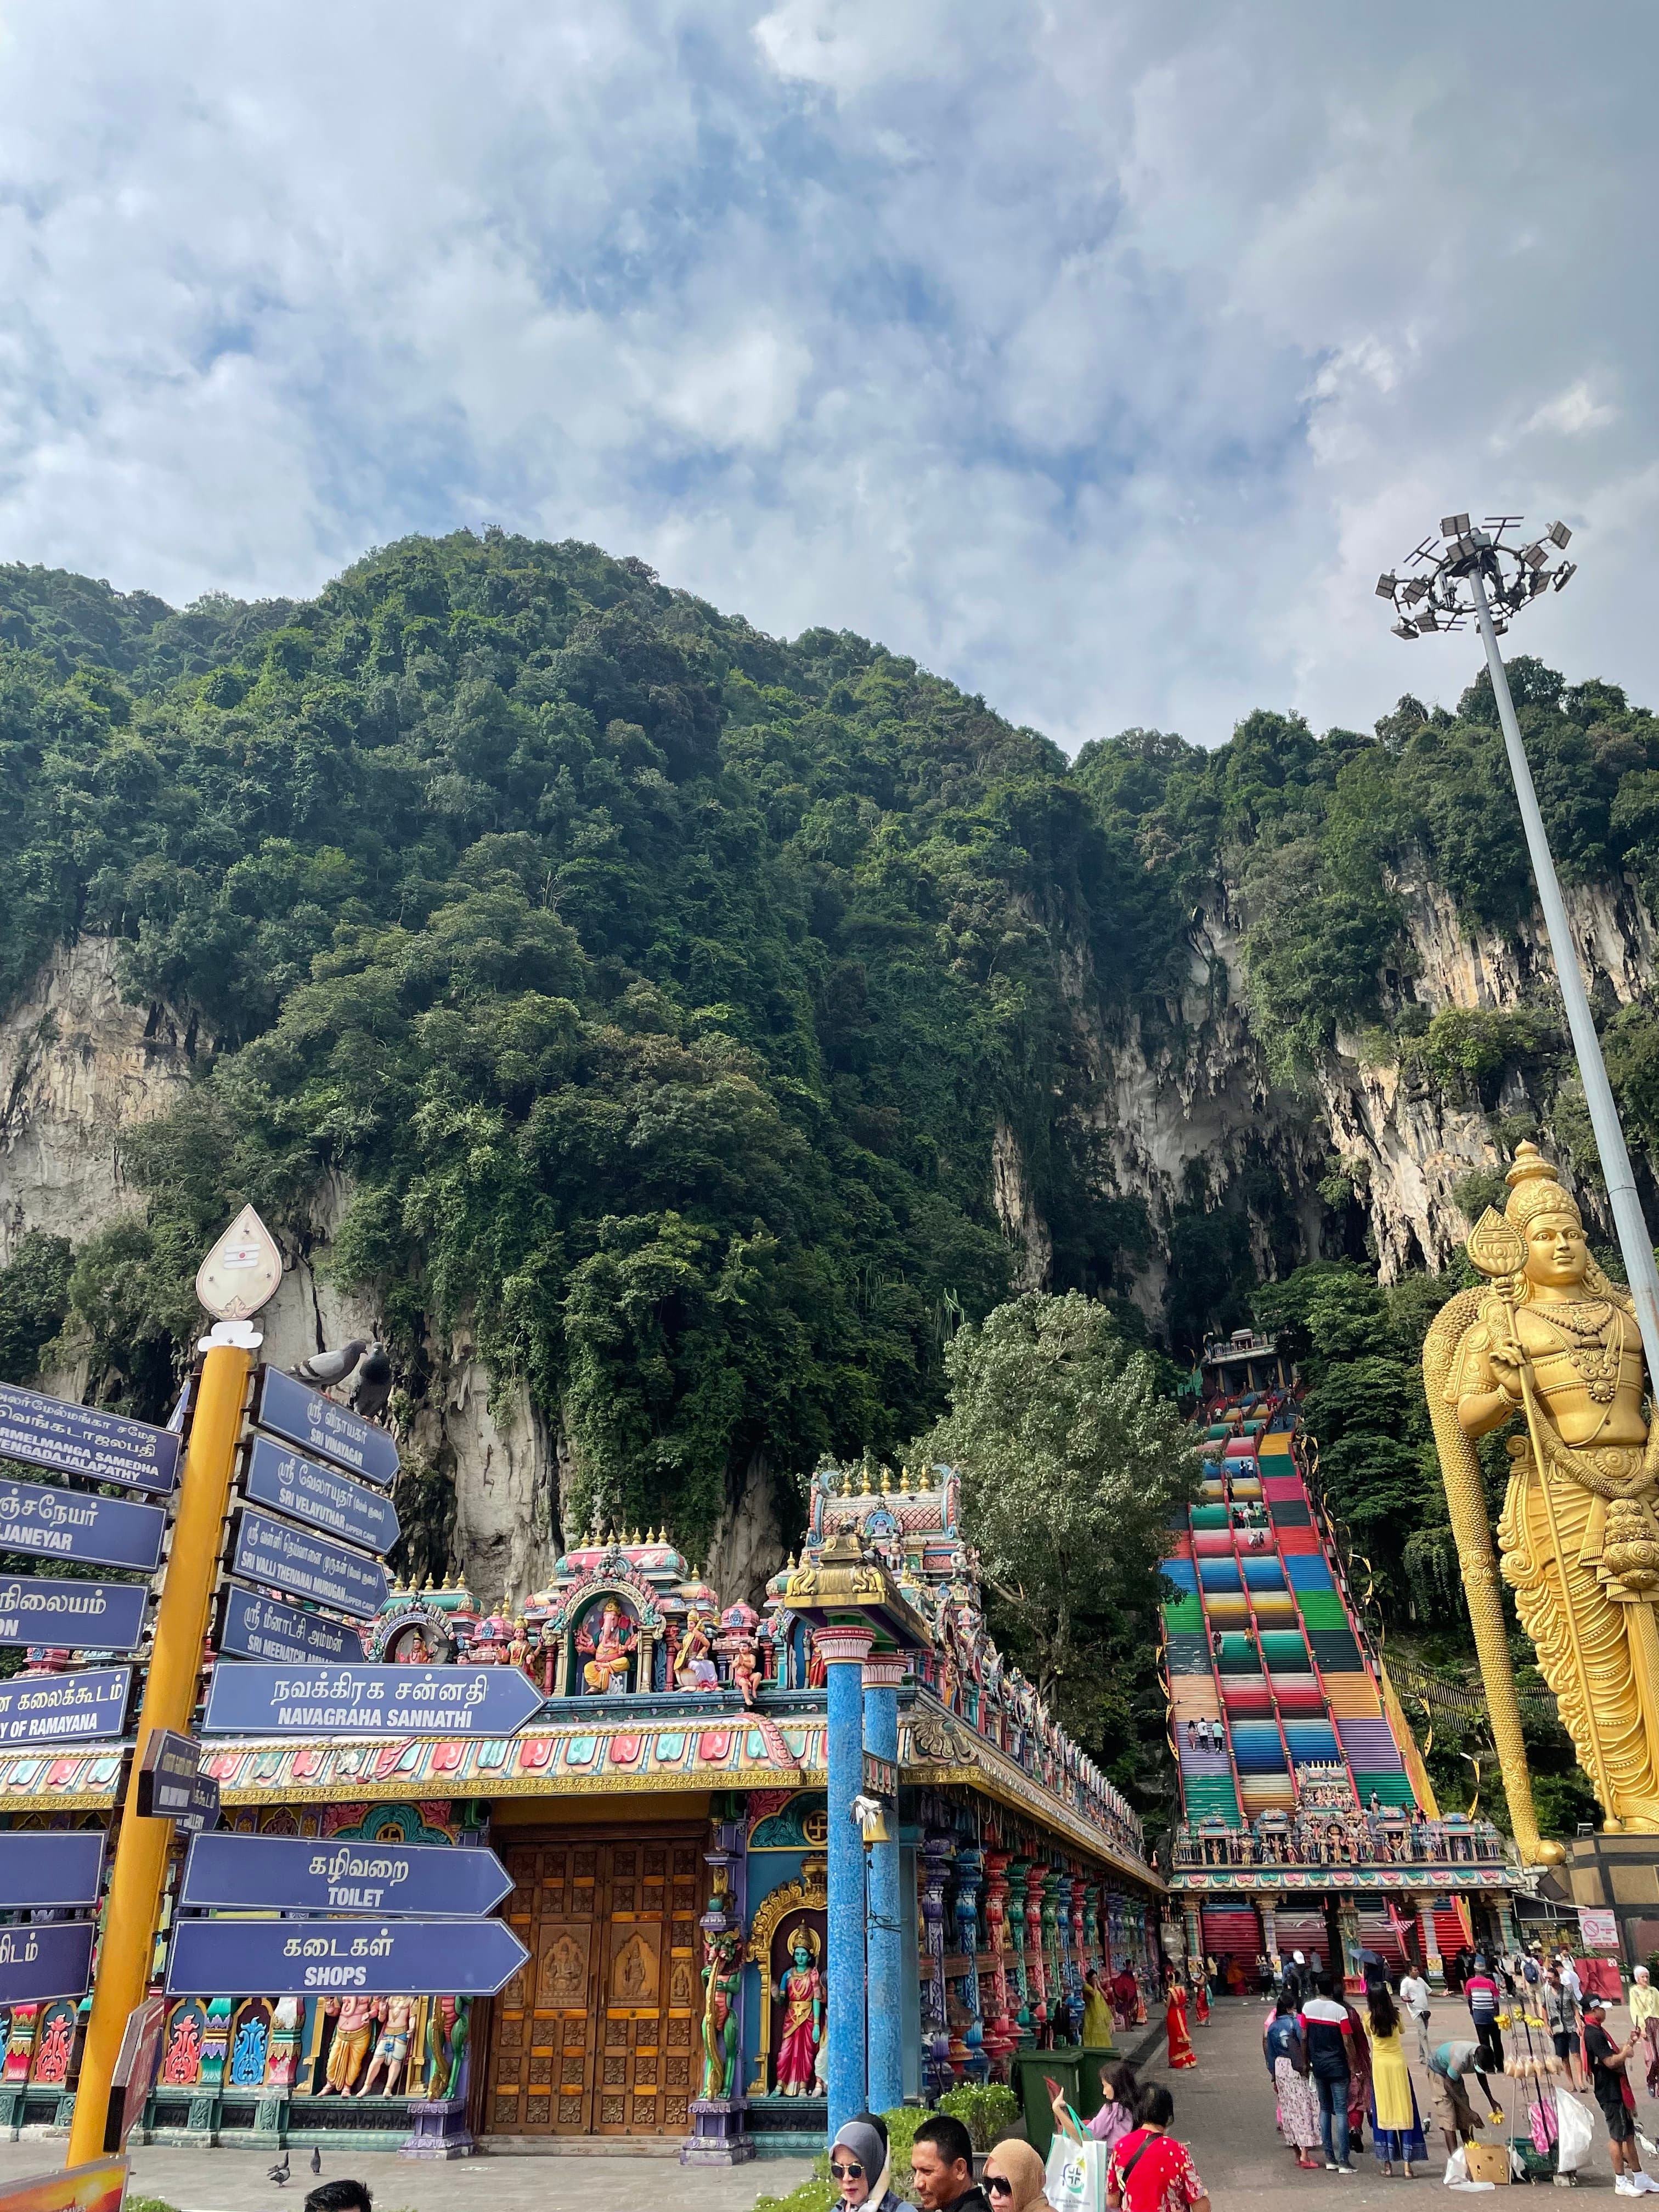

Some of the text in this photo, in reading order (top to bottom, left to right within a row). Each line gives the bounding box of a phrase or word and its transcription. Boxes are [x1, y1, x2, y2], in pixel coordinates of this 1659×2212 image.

[117, 1426, 157, 1443] சமேத
[307, 1400, 368, 1444] ஸ்ரீ விநாயகர்
[0, 1436, 140, 1481] ENGADAJALAPATHY
[95, 1452, 159, 1476] SAMEDHA
[311, 1427, 363, 1467] SRI VINAYAGAR
[278, 1458, 296, 1485] ஸ்ரீ
[299, 1464, 353, 1508] வேலாயுதர்
[279, 1488, 295, 1507] SRI
[295, 1494, 345, 1530] VELAYUTHAR
[0, 1522, 73, 1551] JANEYAR
[241, 1550, 256, 1570] SRI
[256, 1555, 276, 1577] VALLI
[312, 1577, 346, 1602] MURUGAN
[244, 1601, 343, 1653] ஸ்ரீ மீனாட்சி அம்மன்
[247, 1634, 263, 1653] SRI
[17, 1674, 123, 1712] கலைக்கூடம்
[270, 1672, 488, 1709] நவக்கிரக சன்னதி
[10, 1720, 27, 1738] OF
[28, 1713, 98, 1737] RAMAYANA
[277, 1707, 473, 1728] NAVAGRAHA SANNATHI
[308, 1848, 409, 1887] கழிவறை
[328, 1887, 384, 1908] TOILET
[283, 1928, 395, 1957] கடைகள்
[303, 1966, 367, 1987] SHOPS
